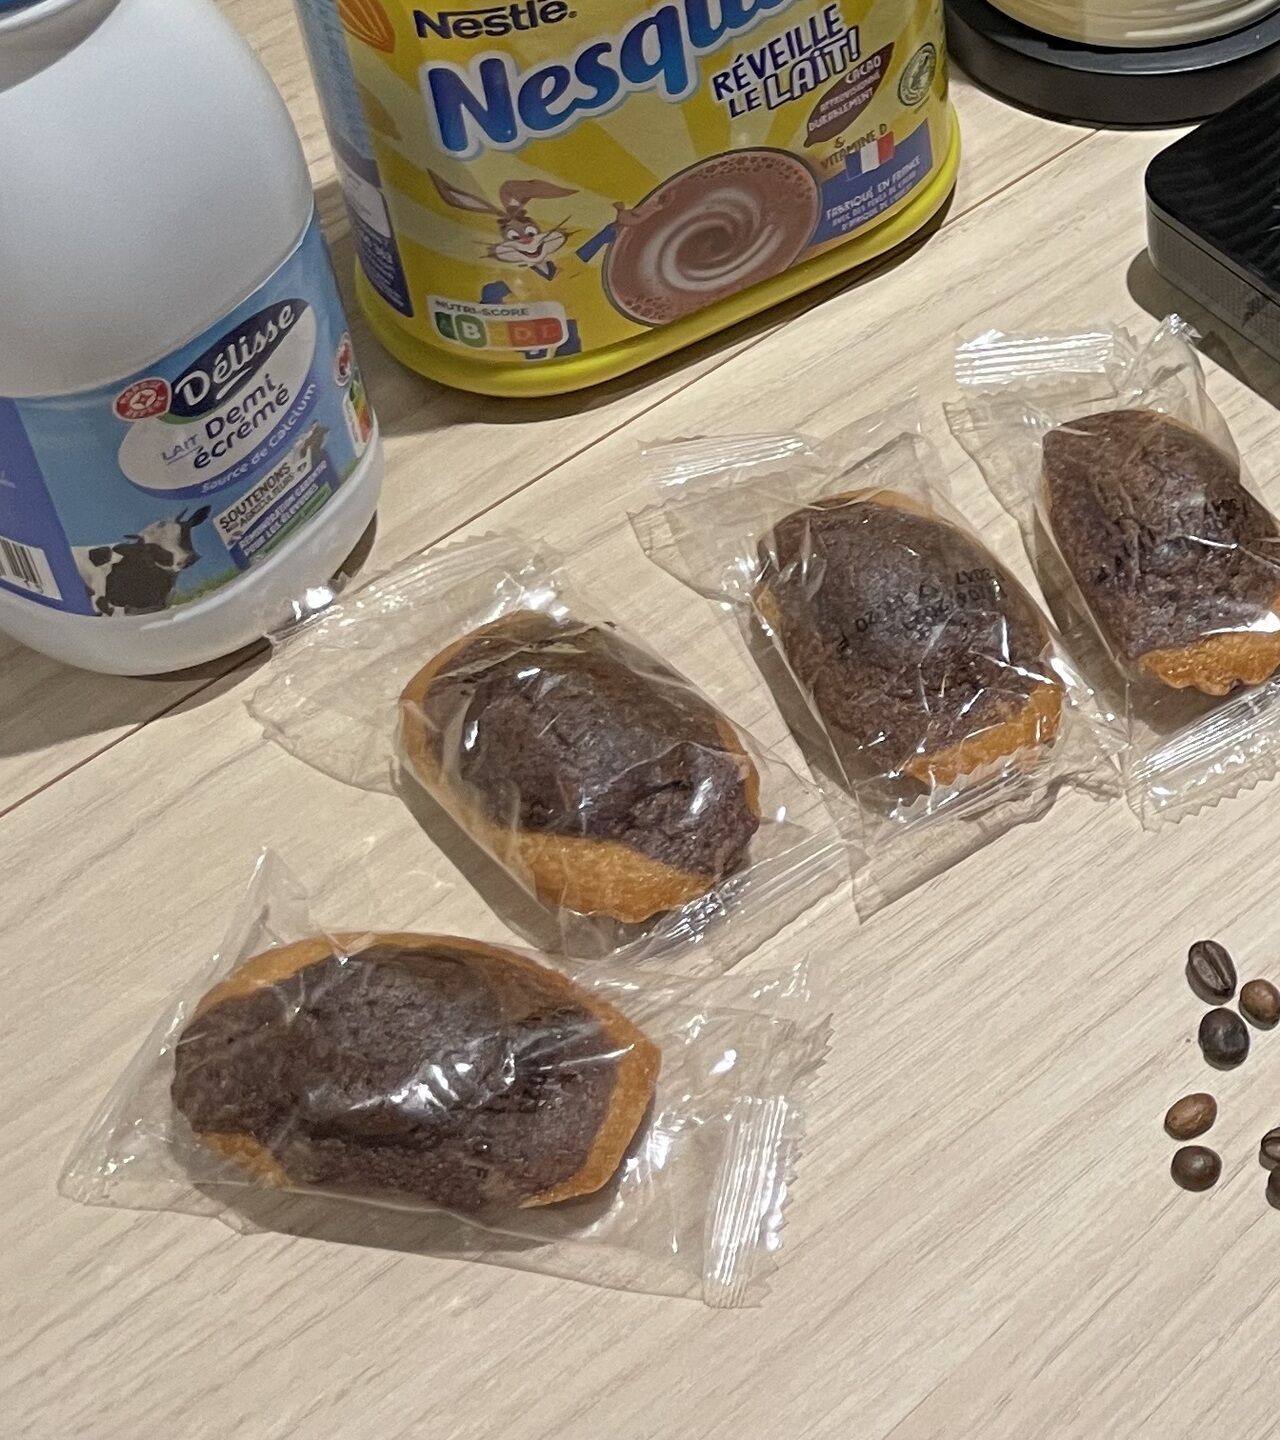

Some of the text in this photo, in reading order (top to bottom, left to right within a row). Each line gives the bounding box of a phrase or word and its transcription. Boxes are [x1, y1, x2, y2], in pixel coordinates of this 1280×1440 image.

[712, 3, 844, 101] RÉVEILLE
[846, 55, 881, 84] CACAO
[728, 89, 762, 118] LE
[819, 133, 877, 169] VITAMINE
[826, 184, 874, 221] FABRIQUÉ
[877, 178, 892, 195] EN
[890, 156, 921, 186] FRANCE
[434, 299, 531, 317] NUTRI-SCORE
[461, 320, 481, 340] B
[174, 304, 295, 406] Délisse
[193, 382, 290, 470] écrémé
[205, 373, 277, 440] Demi
[201, 461, 249, 494] Source
[251, 448, 269, 465] de
[220, 462, 291, 530] SOUTENONS
